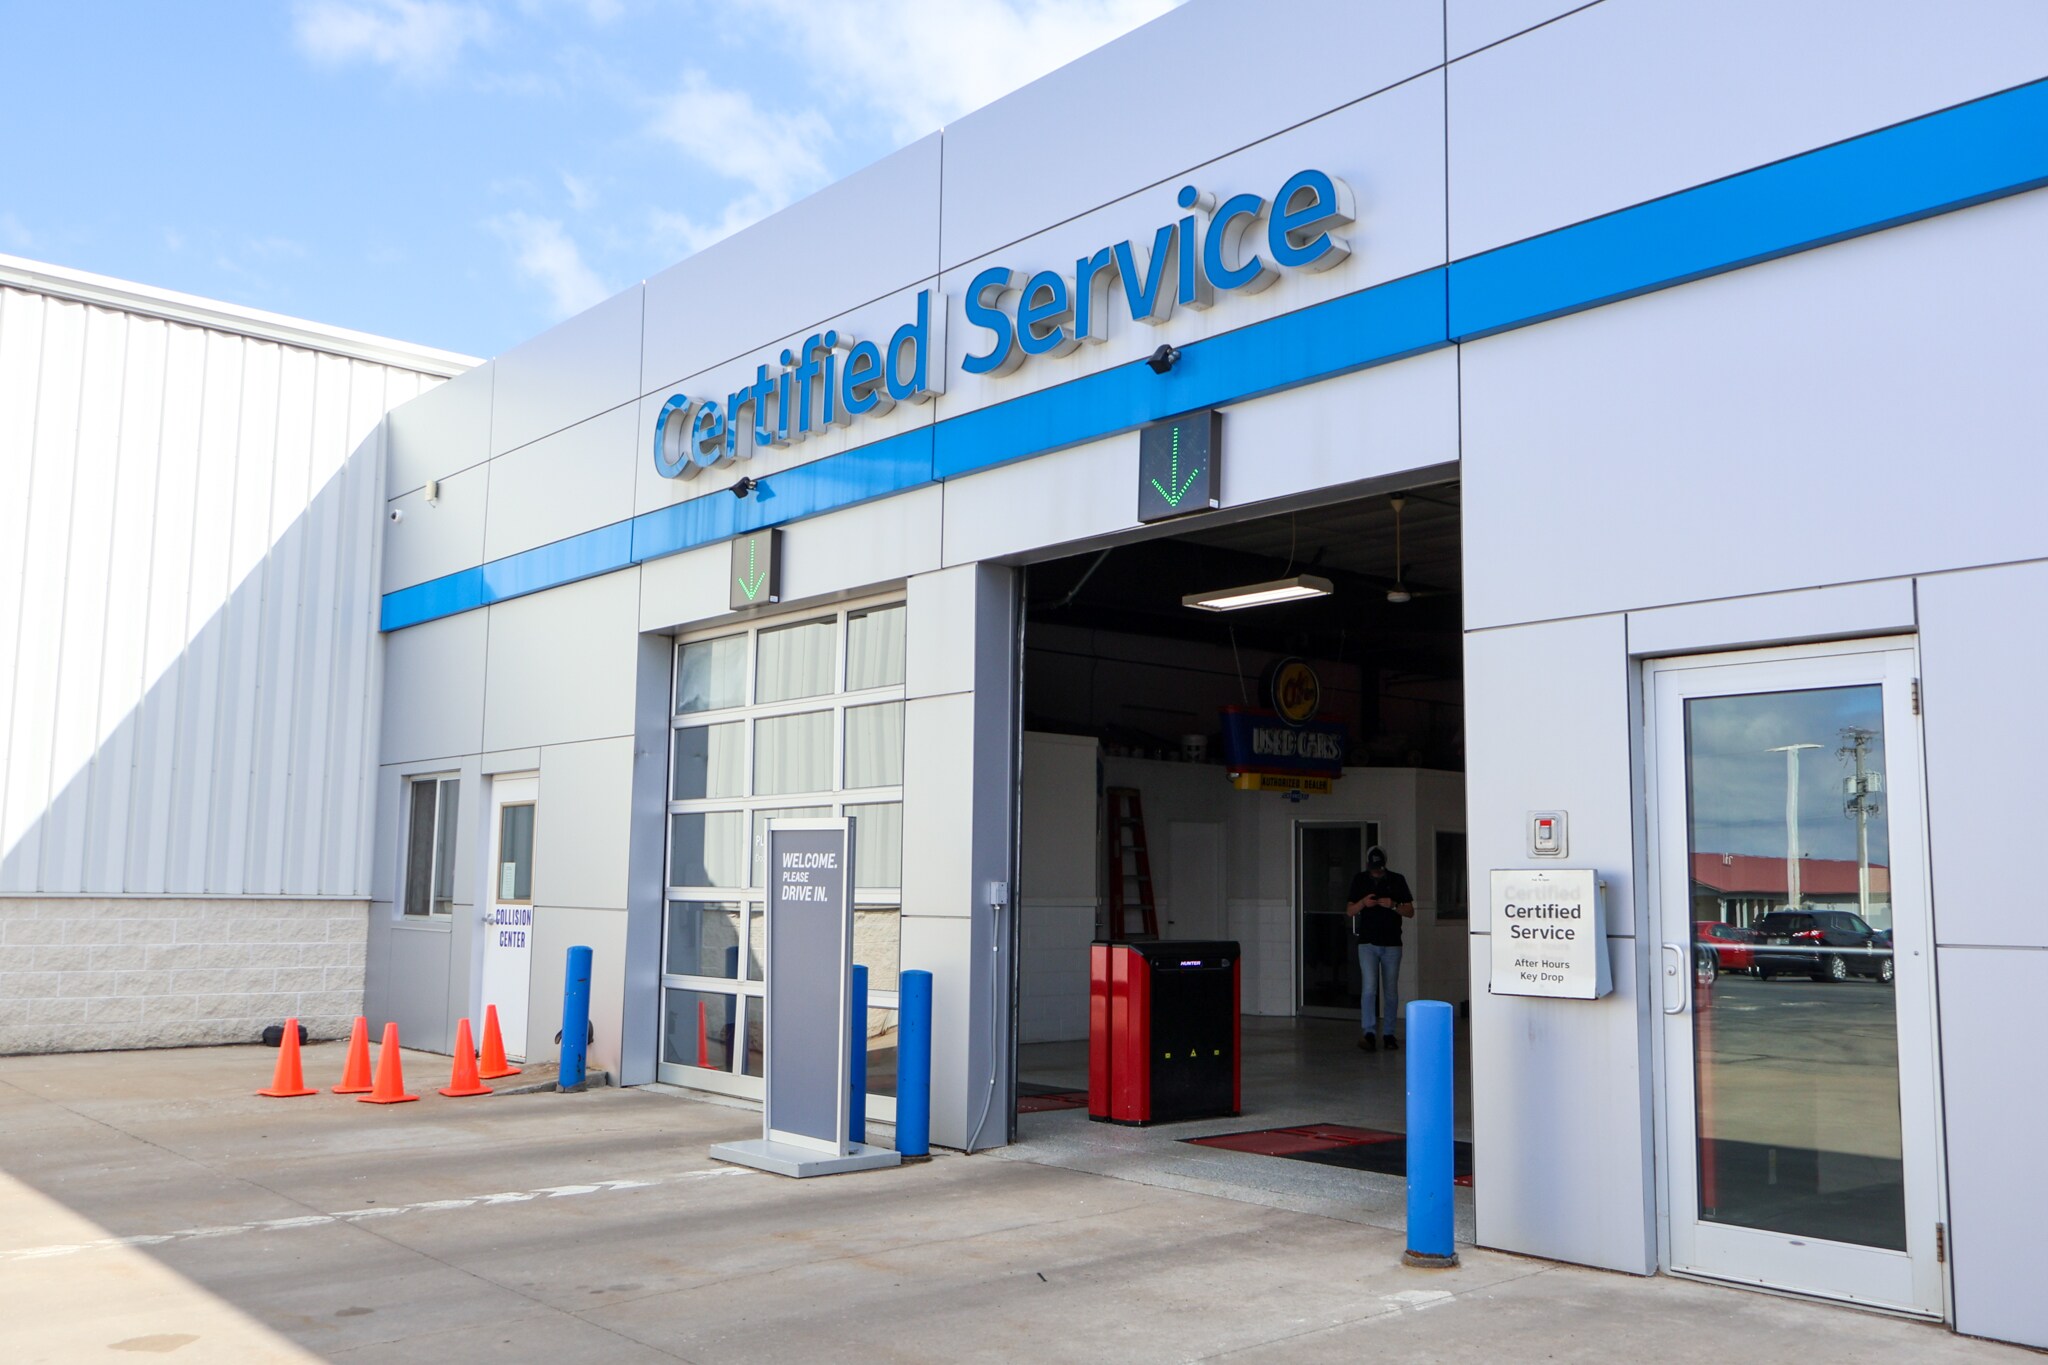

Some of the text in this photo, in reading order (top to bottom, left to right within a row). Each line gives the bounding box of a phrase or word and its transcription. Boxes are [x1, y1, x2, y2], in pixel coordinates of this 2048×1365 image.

[653, 168, 1348, 480] Certified Service
[1253, 727, 1341, 760] USED CARS
[1262, 776, 1328, 790] AUTHORIZED DEALER
[782, 852, 838, 868] WELCOME.
[782, 871, 810, 882] PLEASE
[782, 885, 828, 902] DRIVE IN.
[496, 909, 531, 926] COLLISION
[1504, 903, 1582, 919] Certified
[500, 931, 525, 948] CENTER
[1510, 924, 1575, 941] Service
[1514, 958, 1570, 969] After Hours
[1520, 971, 1564, 984] Key Drop
